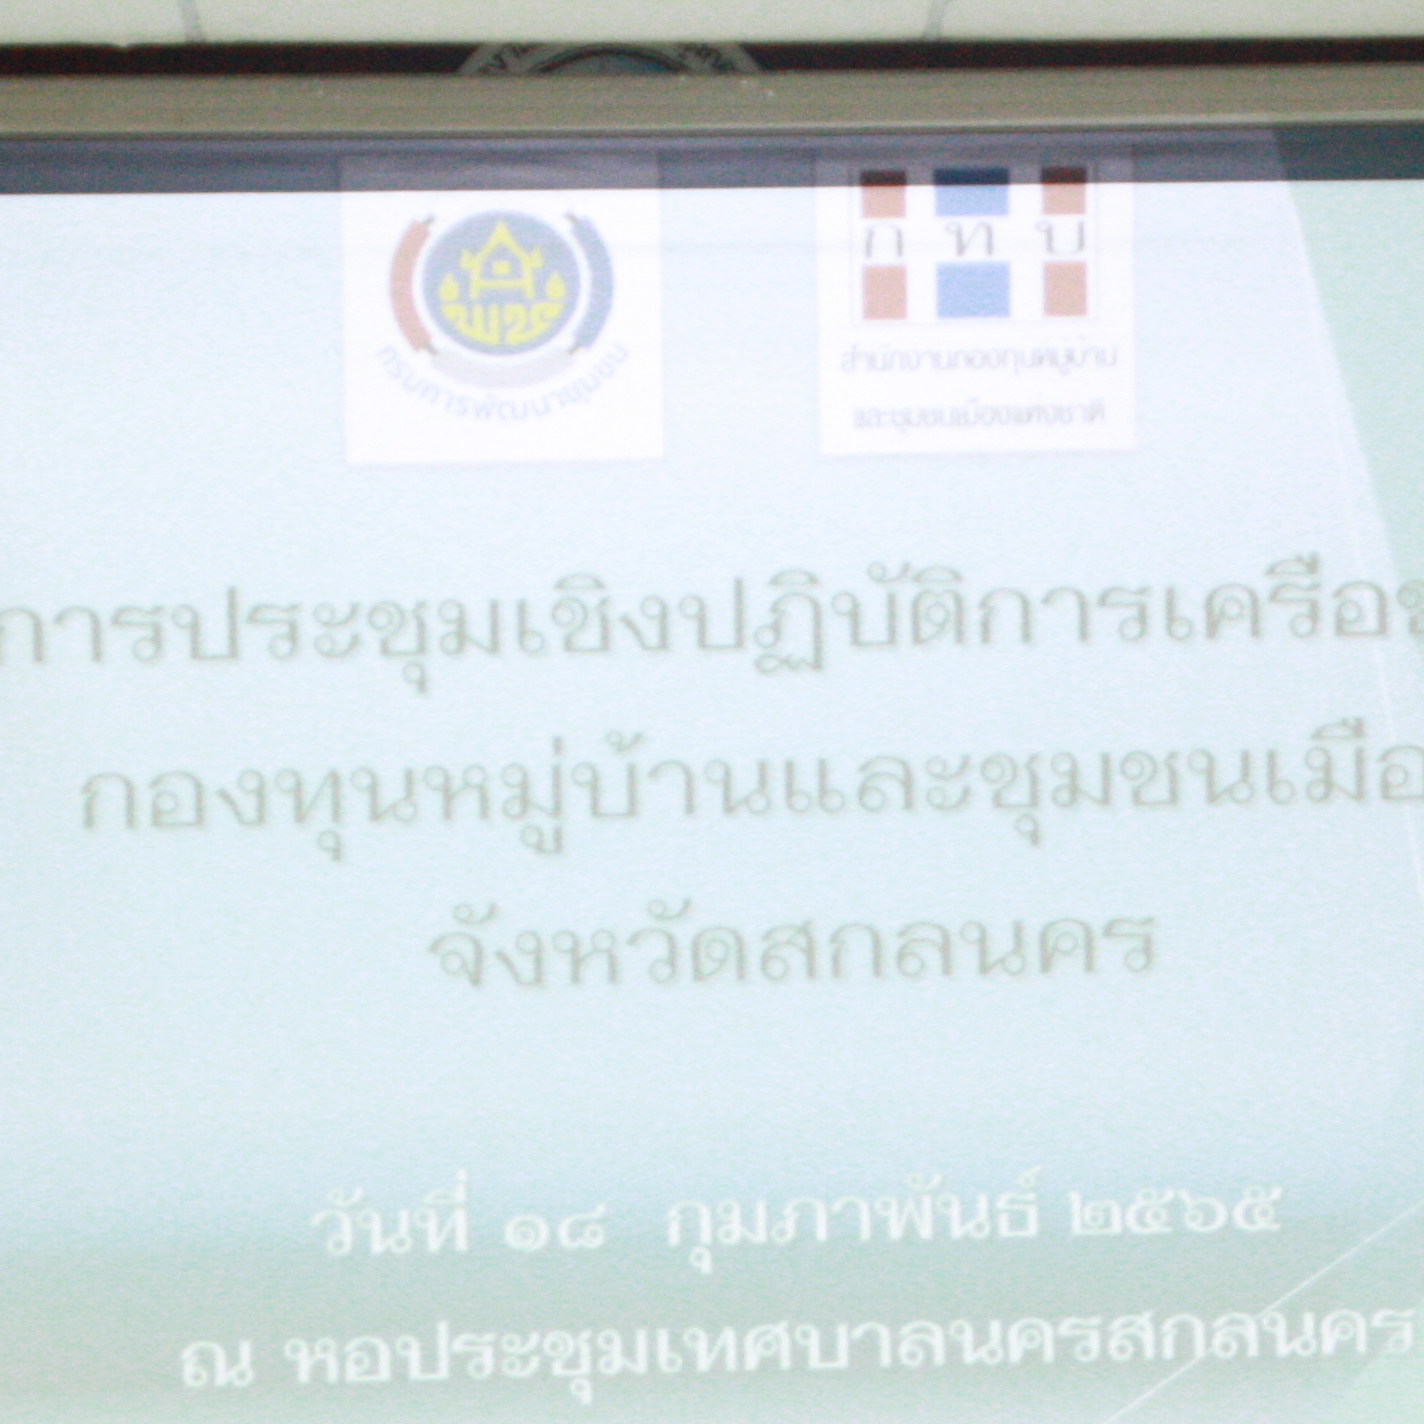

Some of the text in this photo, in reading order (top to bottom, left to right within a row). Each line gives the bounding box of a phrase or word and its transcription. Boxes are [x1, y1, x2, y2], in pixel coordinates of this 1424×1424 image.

[428, 898, 1157, 989] จังหวัดสกลนคร
[310, 1164, 1285, 1275] วันที่ ๑๘ กุมภาพันธ์ ๒๕๖๕
[179, 1308, 1417, 1406] ณ หอประชุมเทศบาลนครสกลนคร
